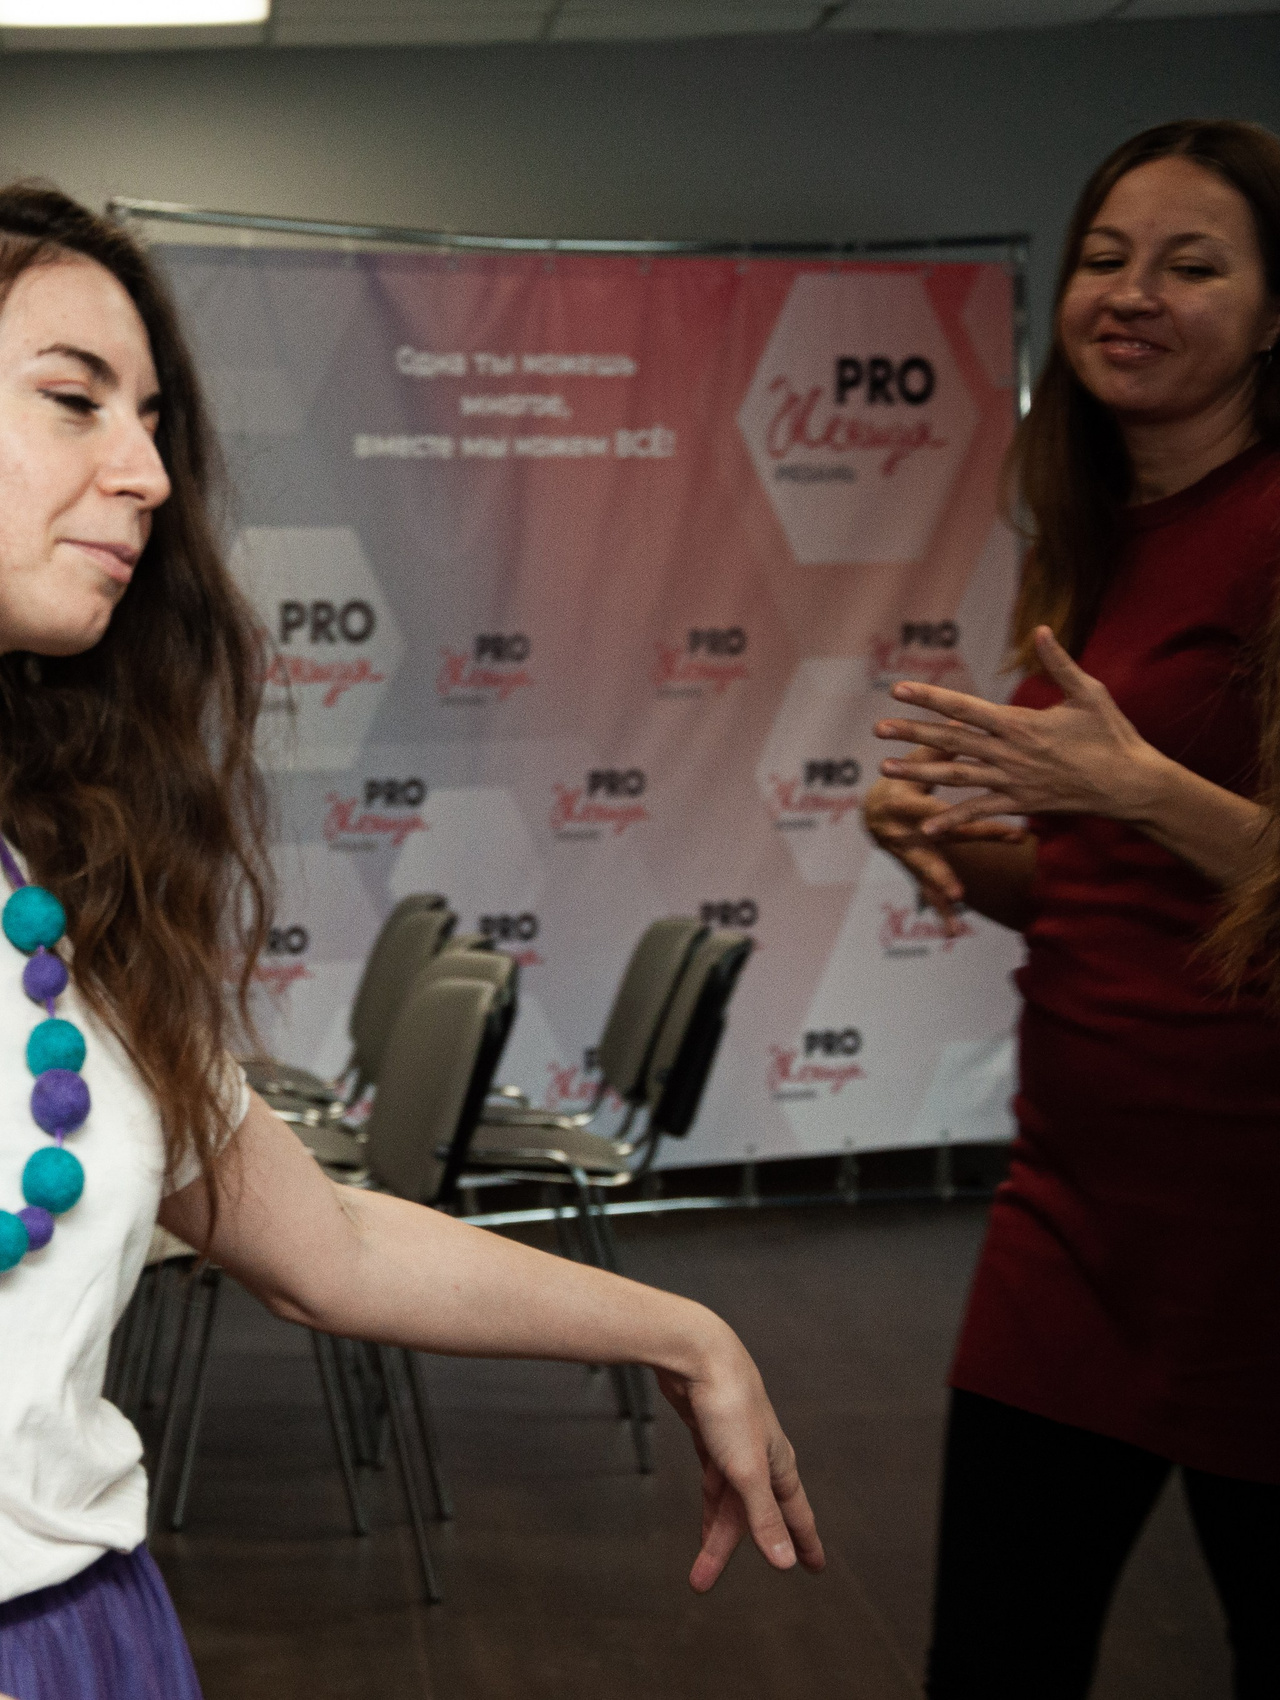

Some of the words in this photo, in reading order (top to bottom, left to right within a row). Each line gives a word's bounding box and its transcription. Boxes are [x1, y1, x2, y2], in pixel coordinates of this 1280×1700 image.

[474, 353, 515, 375] ты
[835, 355, 936, 406] PRO
[279, 600, 376, 643] PRO
[901, 620, 959, 648] PRO
[475, 633, 531, 662] PRO
[687, 627, 747, 656] PRO
[587, 768, 646, 797] PRO
[804, 759, 860, 788] PRO
[364, 778, 427, 807] PRO
[480, 912, 538, 941] PRO
[700, 900, 758, 927] PRO
[805, 1028, 862, 1057] PRO
